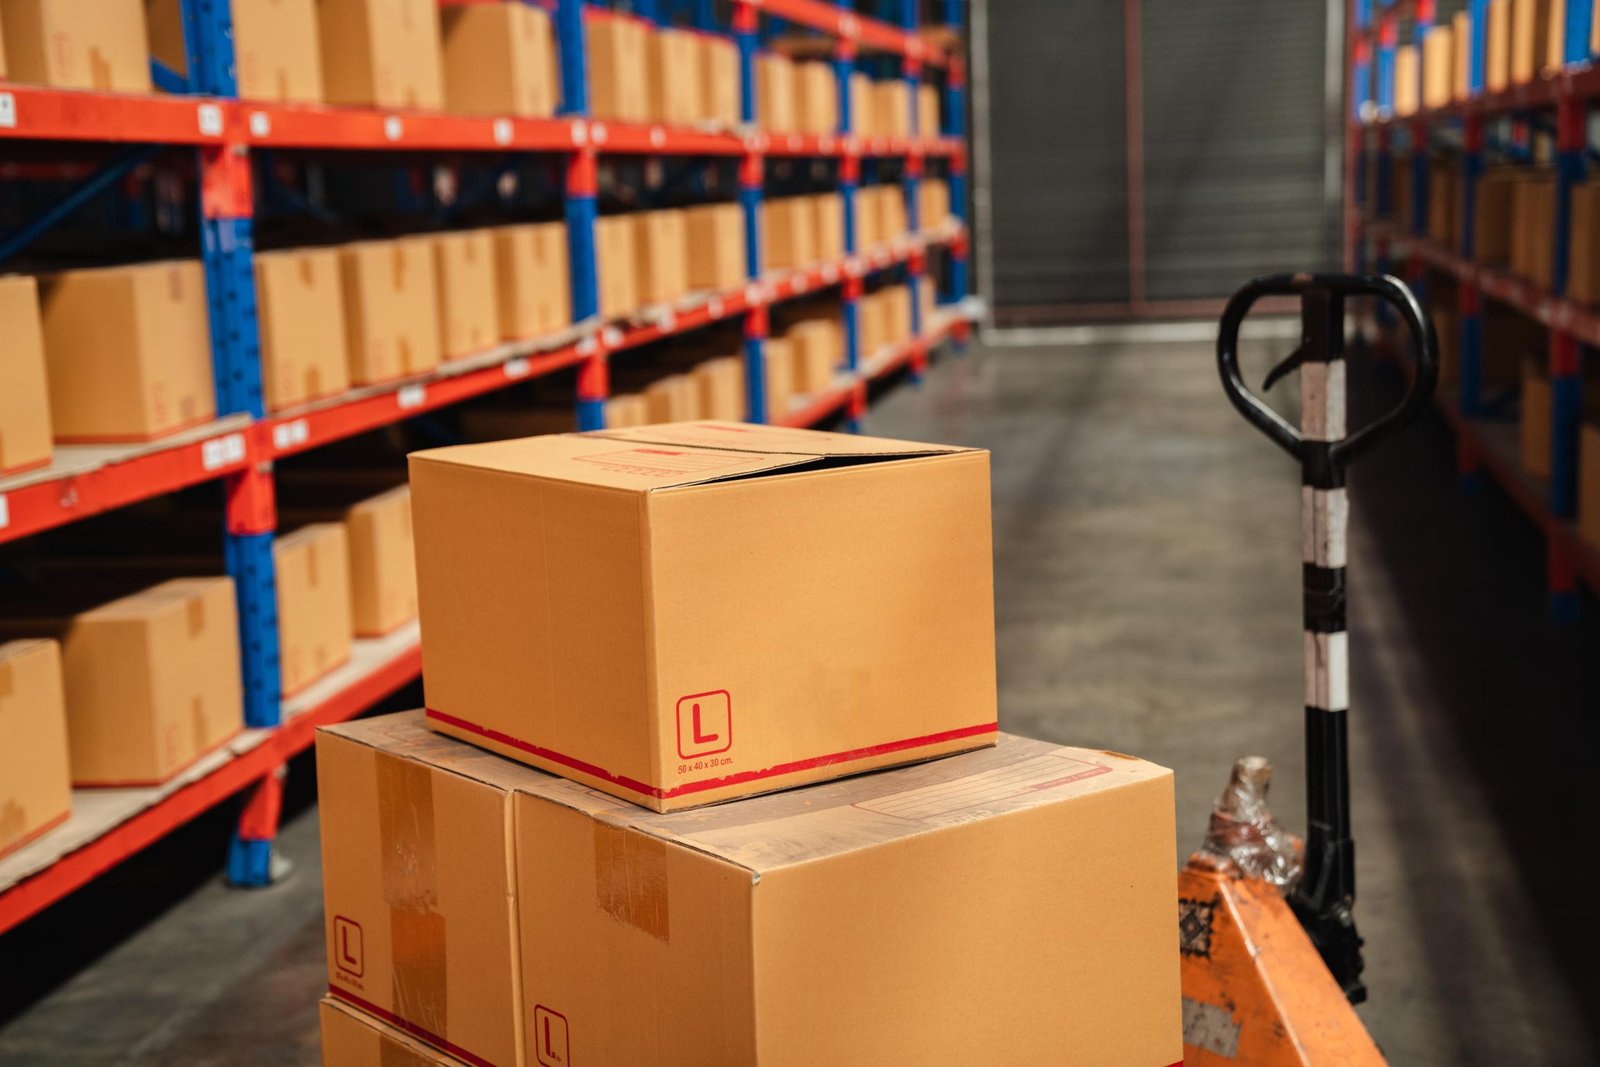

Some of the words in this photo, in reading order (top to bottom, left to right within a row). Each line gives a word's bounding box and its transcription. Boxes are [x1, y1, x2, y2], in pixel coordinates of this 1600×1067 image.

[692, 703, 719, 744] L
[678, 764, 687, 775] 50
[694, 761, 703, 770] 40
[710, 758, 719, 767] 30
[720, 757, 734, 765] cm.
[342, 925, 357, 965] L
[544, 1016, 562, 1062] L
